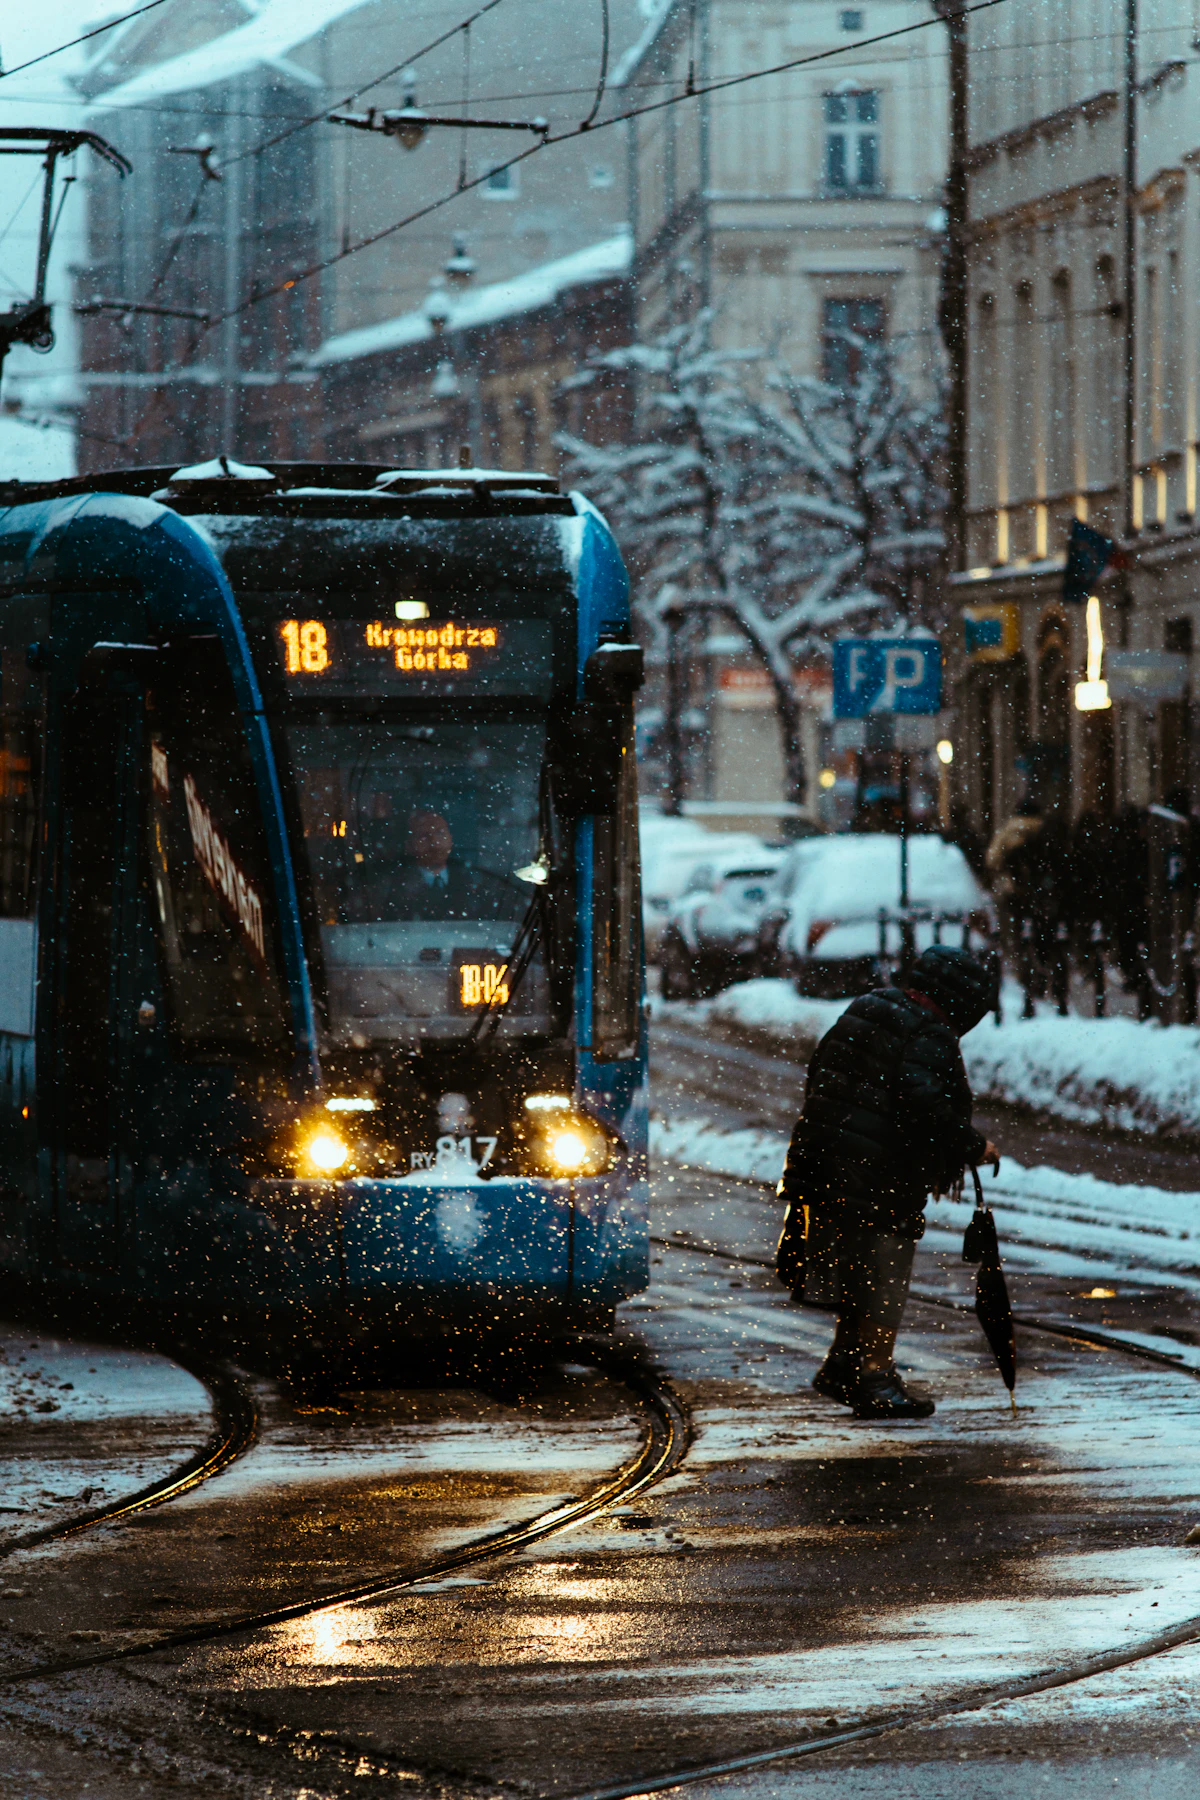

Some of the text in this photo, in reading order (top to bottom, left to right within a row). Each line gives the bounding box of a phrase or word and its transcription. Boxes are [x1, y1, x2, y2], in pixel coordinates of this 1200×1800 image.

[281, 619, 328, 673] 18
[366, 621, 497, 647] Krowodrza
[396, 646, 468, 671] Górka
[885, 648, 925, 705] P
